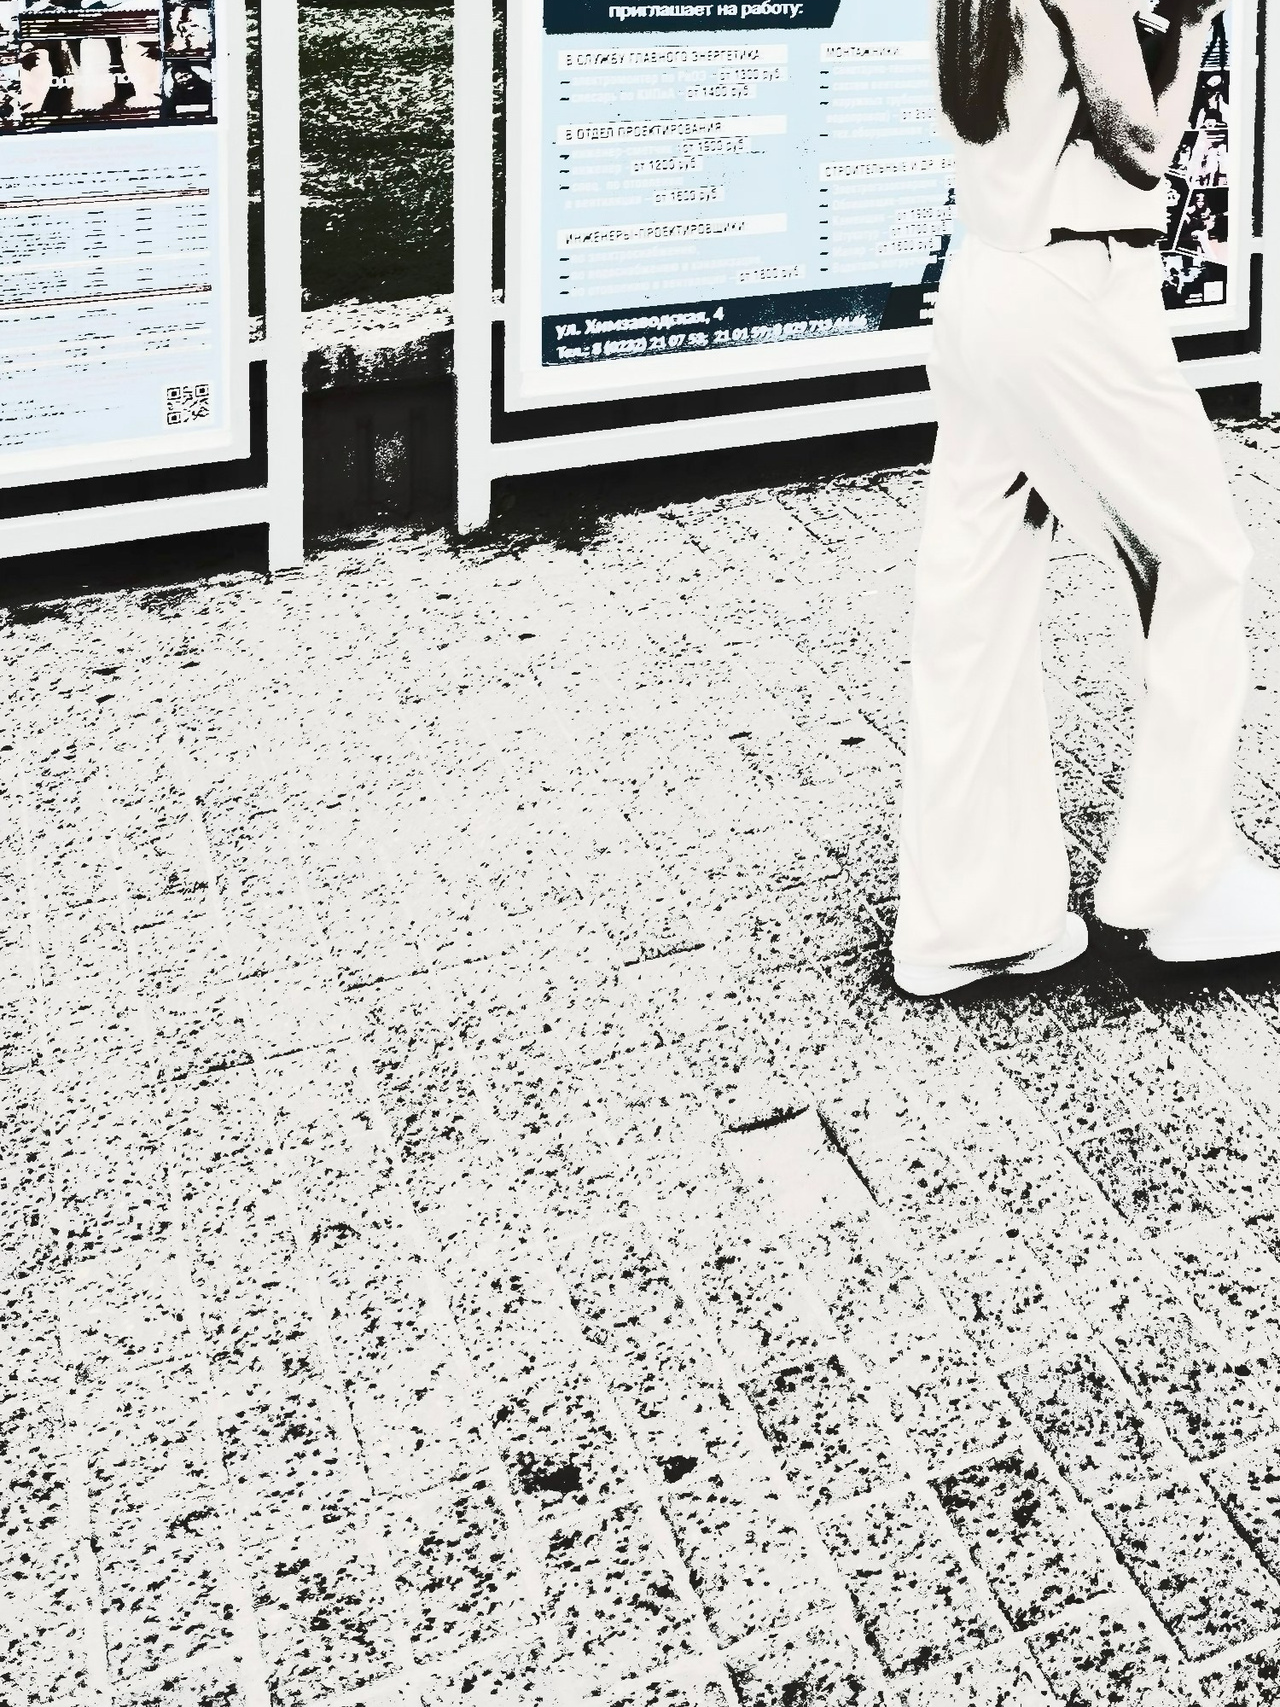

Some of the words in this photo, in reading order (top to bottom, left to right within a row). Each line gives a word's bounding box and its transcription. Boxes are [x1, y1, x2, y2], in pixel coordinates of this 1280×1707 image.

[608, 1, 713, 21] приглашает
[716, 3, 738, 16] на
[740, 0, 804, 19] работу:
[577, 52, 625, 66] СЛУЖБУ
[629, 51, 688, 64] ГЛАВНОГО
[577, 127, 614, 140] ОТДЕЛ
[555, 323, 582, 340] ул.
[585, 311, 711, 335] Химзаводская,
[713, 306, 725, 321] 4
